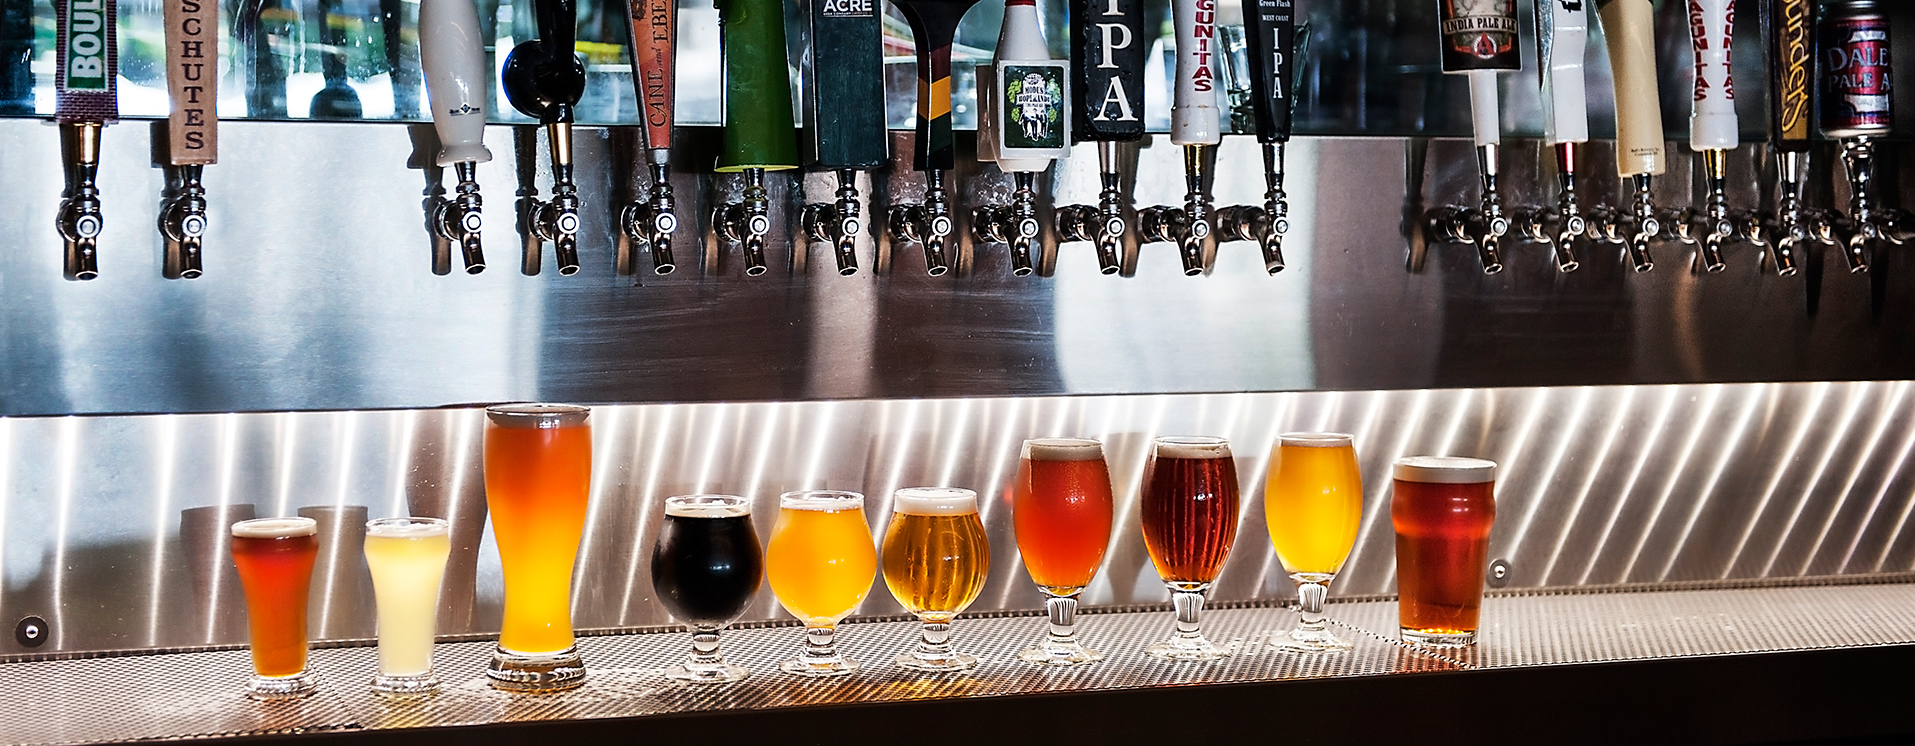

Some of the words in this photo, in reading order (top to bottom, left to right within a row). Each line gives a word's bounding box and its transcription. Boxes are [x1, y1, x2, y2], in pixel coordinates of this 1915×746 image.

[823, 0, 872, 12] ACRE
[1446, 18, 1474, 32] INDIA
[1477, 17, 1500, 29] PALE
[1502, 18, 1516, 32] ALE
[652, 47, 662, 68] and
[1192, 0, 1214, 92] GUNITAS
[1273, 28, 1283, 99] IPA
[181, 0, 204, 150] SCHUTES
[1828, 72, 1874, 93] PALE
[647, 69, 667, 128] CANE
